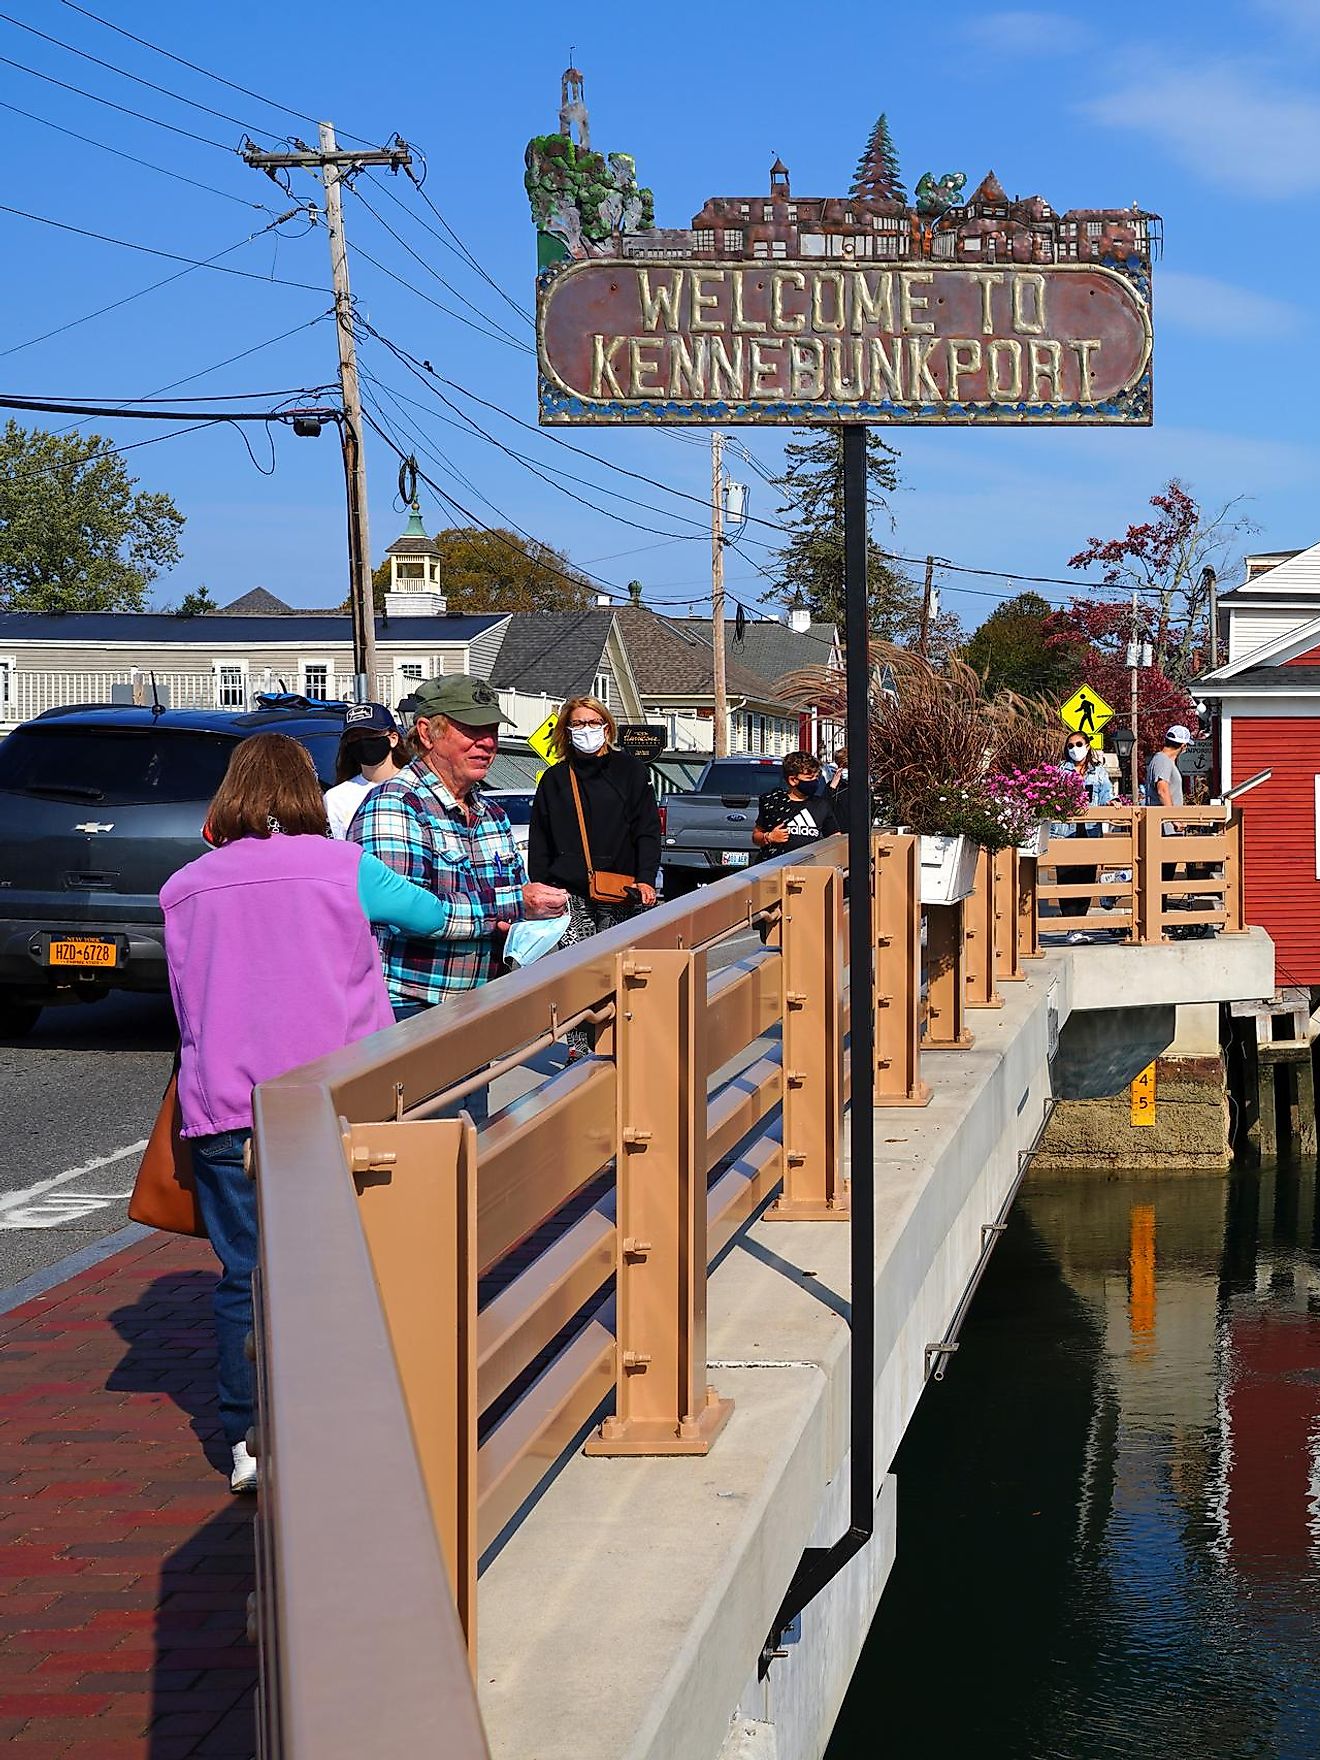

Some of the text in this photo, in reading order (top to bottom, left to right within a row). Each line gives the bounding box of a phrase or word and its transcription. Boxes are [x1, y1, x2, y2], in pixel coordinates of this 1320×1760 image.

[636, 270, 1047, 335] WELCOME TO
[591, 334, 1101, 401] KENNEBUNKPORT
[1139, 1074, 1148, 1086] 4
[1139, 1097, 1148, 1109] 5
